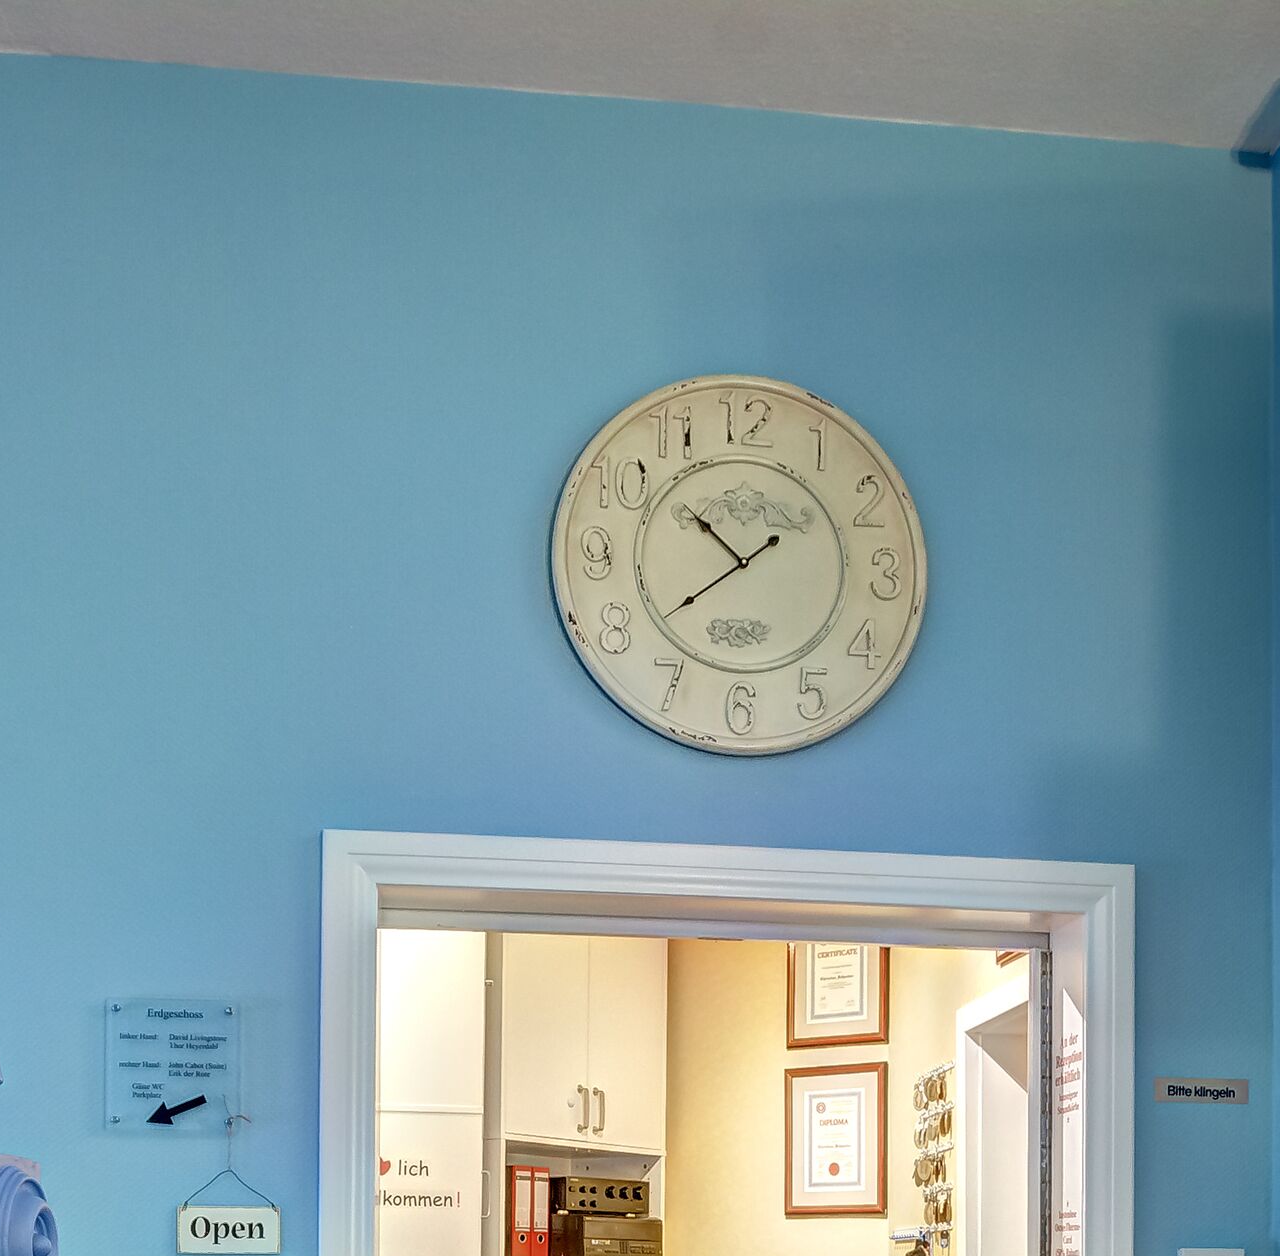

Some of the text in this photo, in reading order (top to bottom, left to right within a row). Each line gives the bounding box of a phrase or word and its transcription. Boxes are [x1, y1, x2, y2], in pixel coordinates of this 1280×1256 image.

[649, 405, 692, 459] 11
[720, 392, 773, 448] 12
[809, 419, 826, 471] 1
[592, 454, 650, 510] 10
[853, 475, 885, 527] 2
[580, 526, 612, 580] 9
[871, 548, 902, 601] 3
[599, 602, 631, 654] 8
[848, 618, 881, 669] 4
[654, 658, 684, 711] 7
[726, 681, 756, 735] 6
[797, 667, 828, 720] 5
[147, 1008, 204, 1020] Erdgeschoss
[1167, 1085, 1235, 1100] Bitte klingeln
[398, 1159, 429, 1176] lich
[190, 1216, 265, 1245] Open
